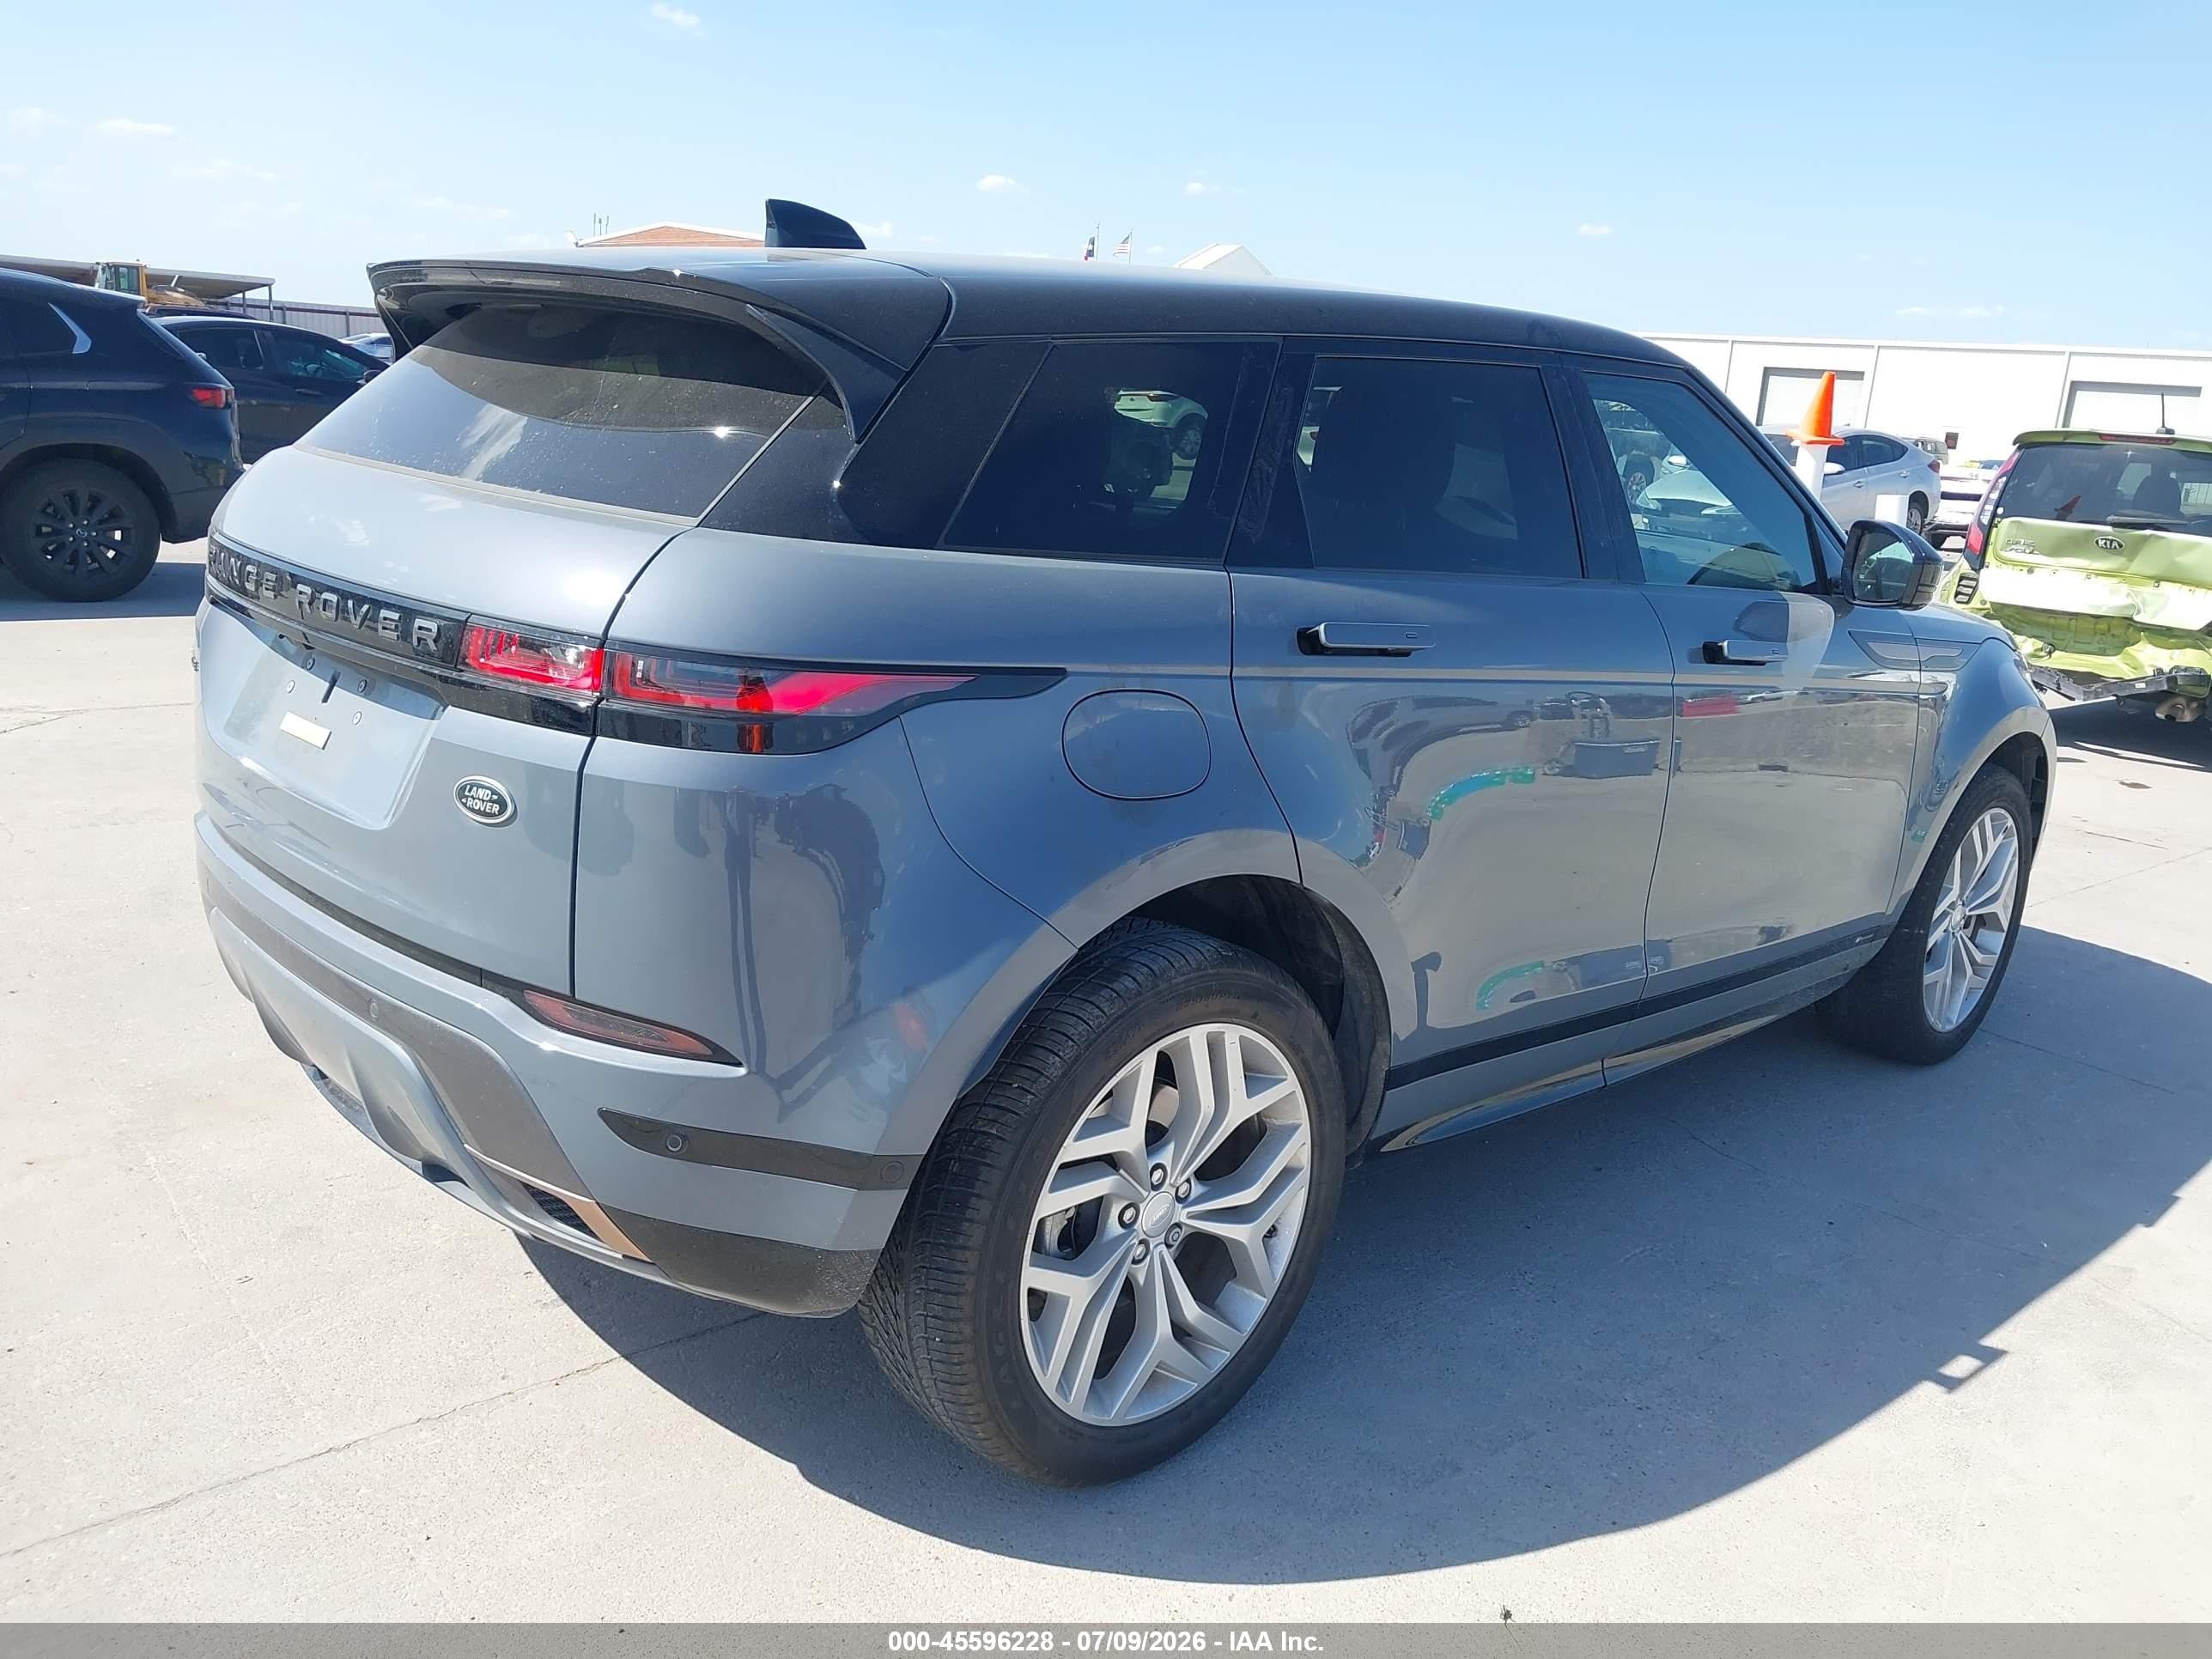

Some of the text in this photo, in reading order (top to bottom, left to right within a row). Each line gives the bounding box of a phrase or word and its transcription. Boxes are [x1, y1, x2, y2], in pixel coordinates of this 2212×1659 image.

[2098, 538, 2120, 550] KIA
[295, 583, 439, 651] ROVER
[465, 784, 492, 801] LAND
[466, 797, 500, 815] ROVER
